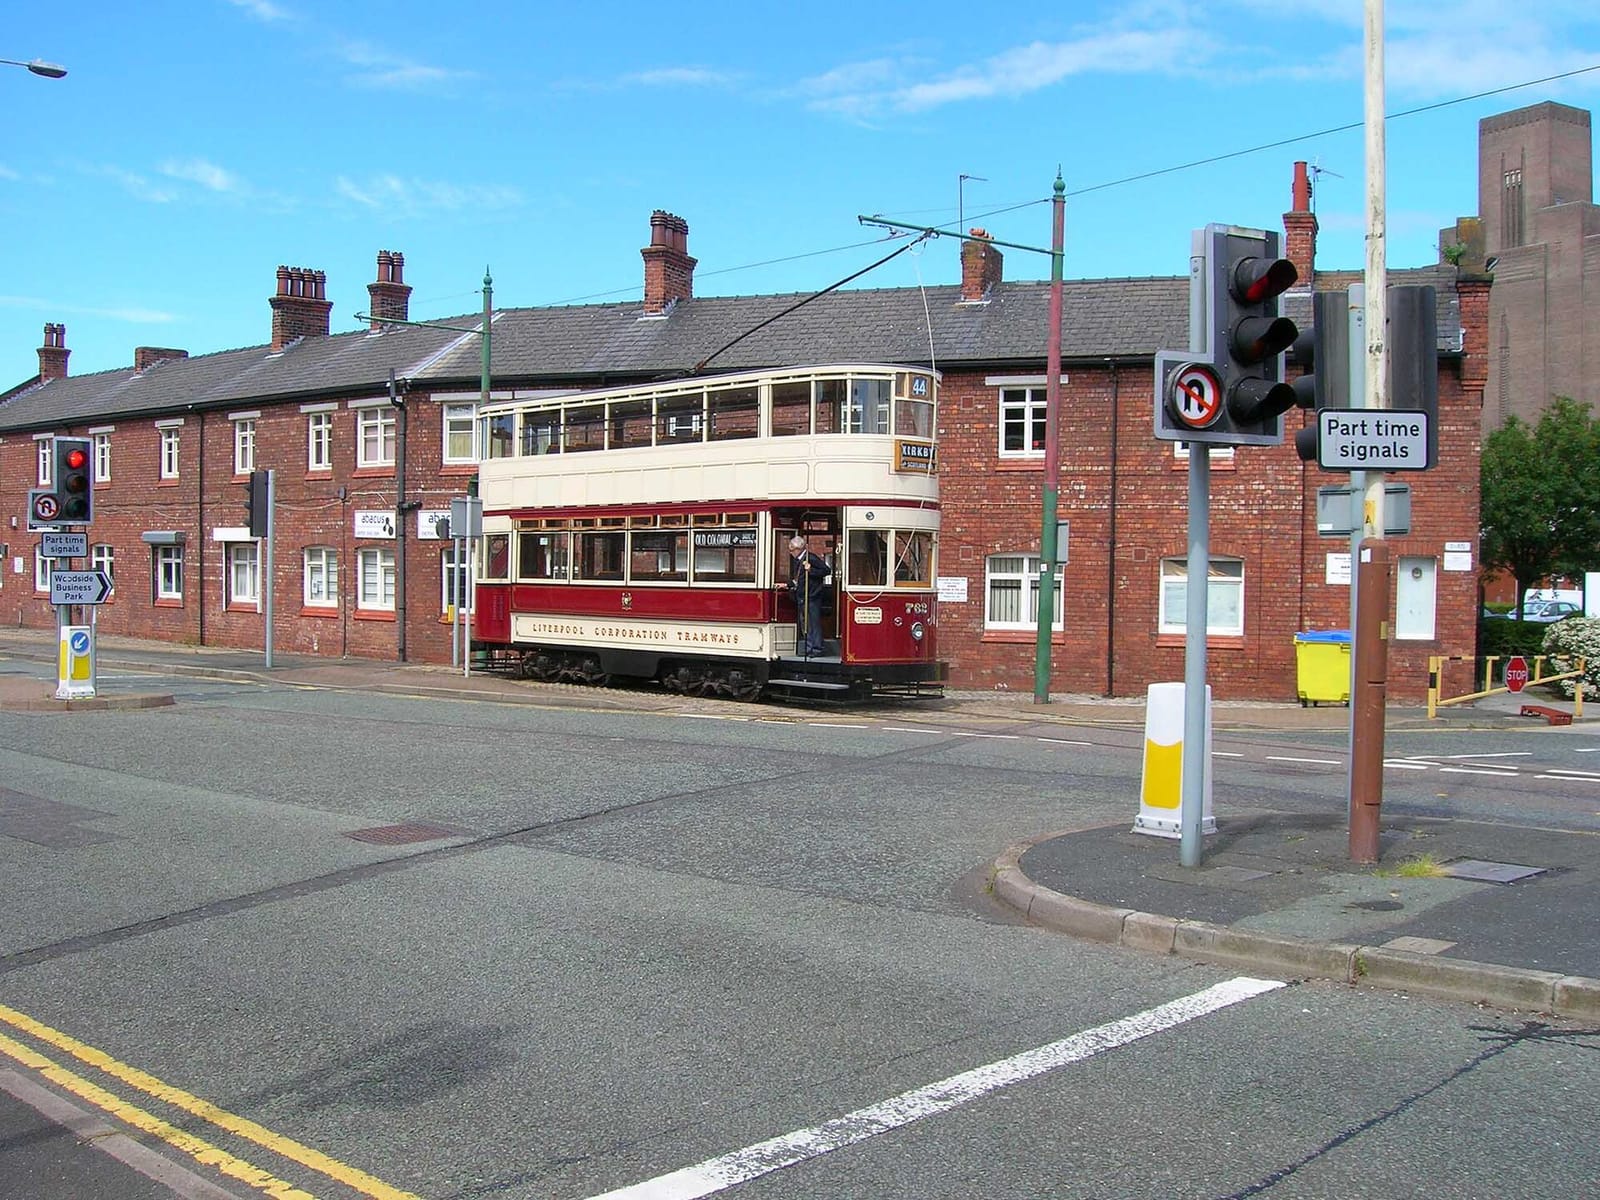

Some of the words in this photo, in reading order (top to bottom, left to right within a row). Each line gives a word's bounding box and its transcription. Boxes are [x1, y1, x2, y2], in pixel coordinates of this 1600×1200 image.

[912, 379, 926, 395] 44
[1327, 419, 1368, 436] Part
[1375, 420, 1420, 437] time
[1340, 441, 1409, 461] signals
[361, 514, 385, 523] abacus
[45, 536, 63, 544] Part
[65, 536, 84, 544] time
[50, 545, 80, 553] signals
[54, 574, 94, 582] Woodside
[56, 583, 92, 592] Business
[64, 592, 84, 601] Park
[905, 602, 928, 614] 762
[532, 623, 585, 636] LIVERPOOL
[594, 627, 667, 640] CORPORATION
[677, 631, 740, 645] TRAMWAYS
[1507, 670, 1527, 680] STOP
